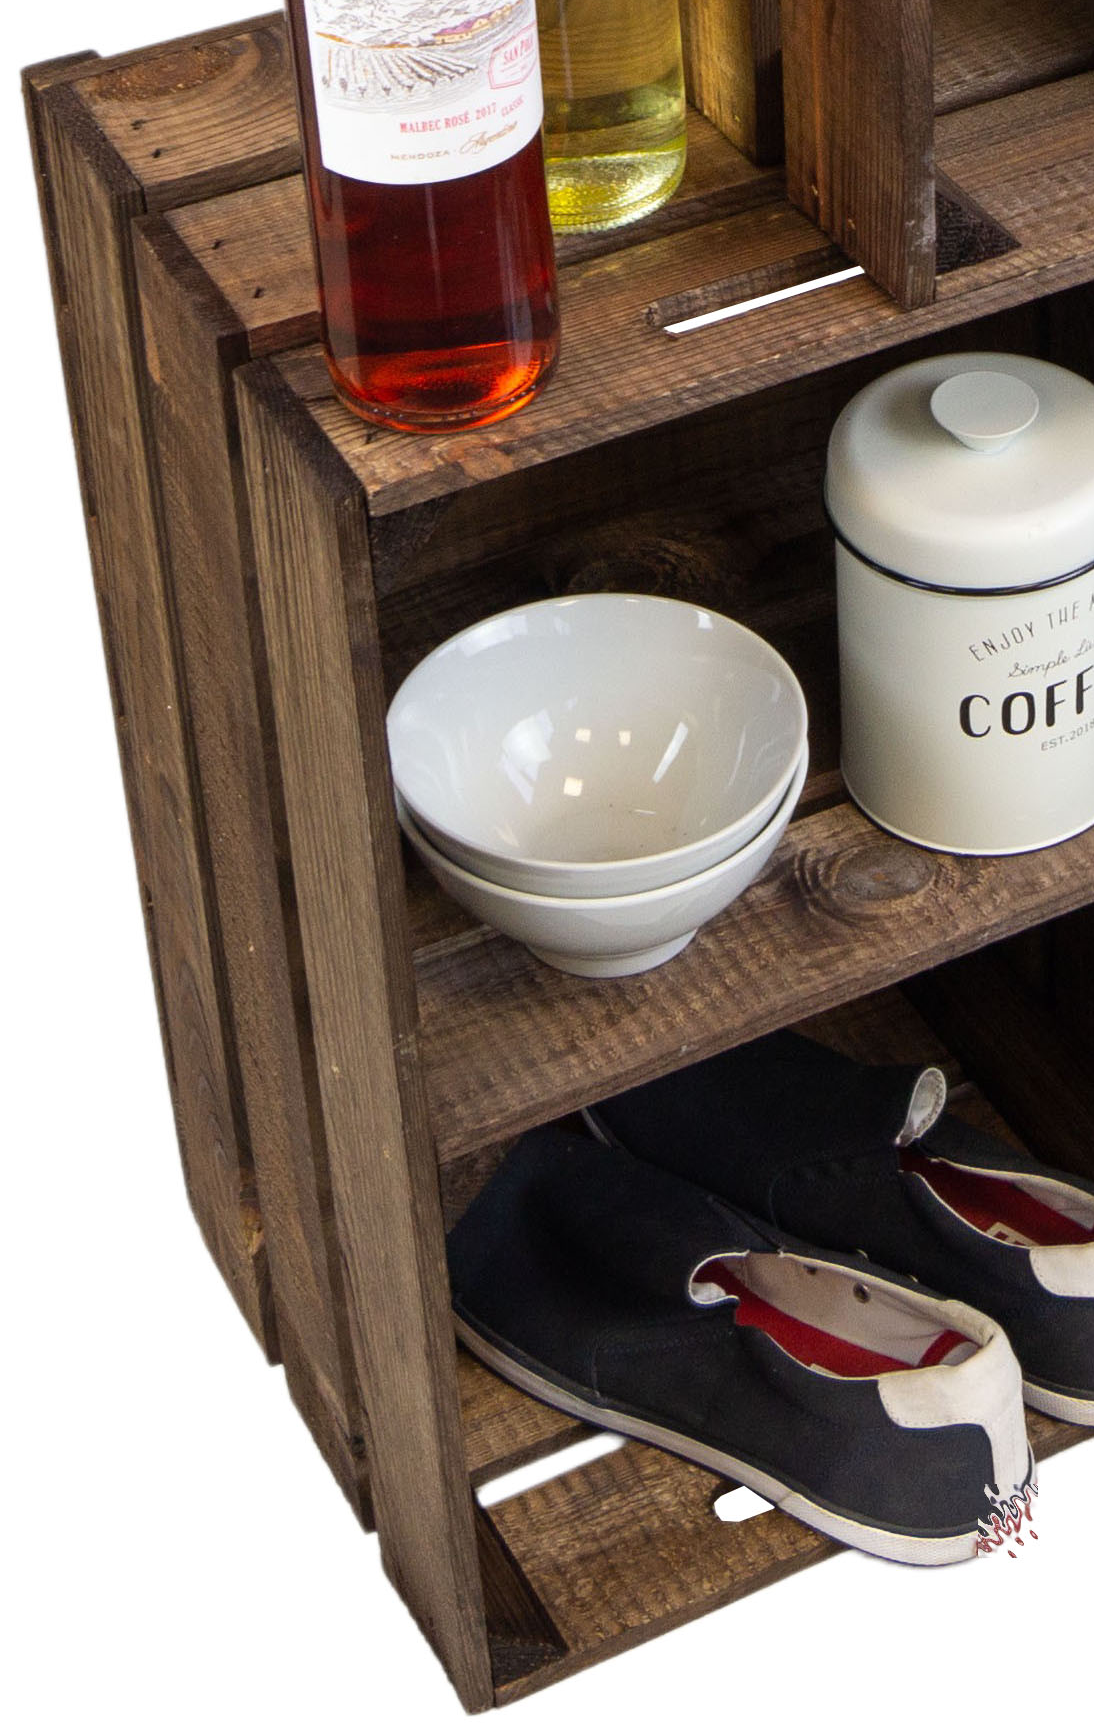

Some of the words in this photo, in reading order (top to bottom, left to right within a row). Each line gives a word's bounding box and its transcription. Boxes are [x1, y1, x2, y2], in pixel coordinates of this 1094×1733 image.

[399, 119, 441, 134] MALBEC
[475, 102, 498, 120] 2017
[390, 149, 450, 161] MENDOZA
[968, 621, 1035, 662] ENJOY
[1047, 600, 1080, 630] THE
[1007, 650, 1071, 679] Simple
